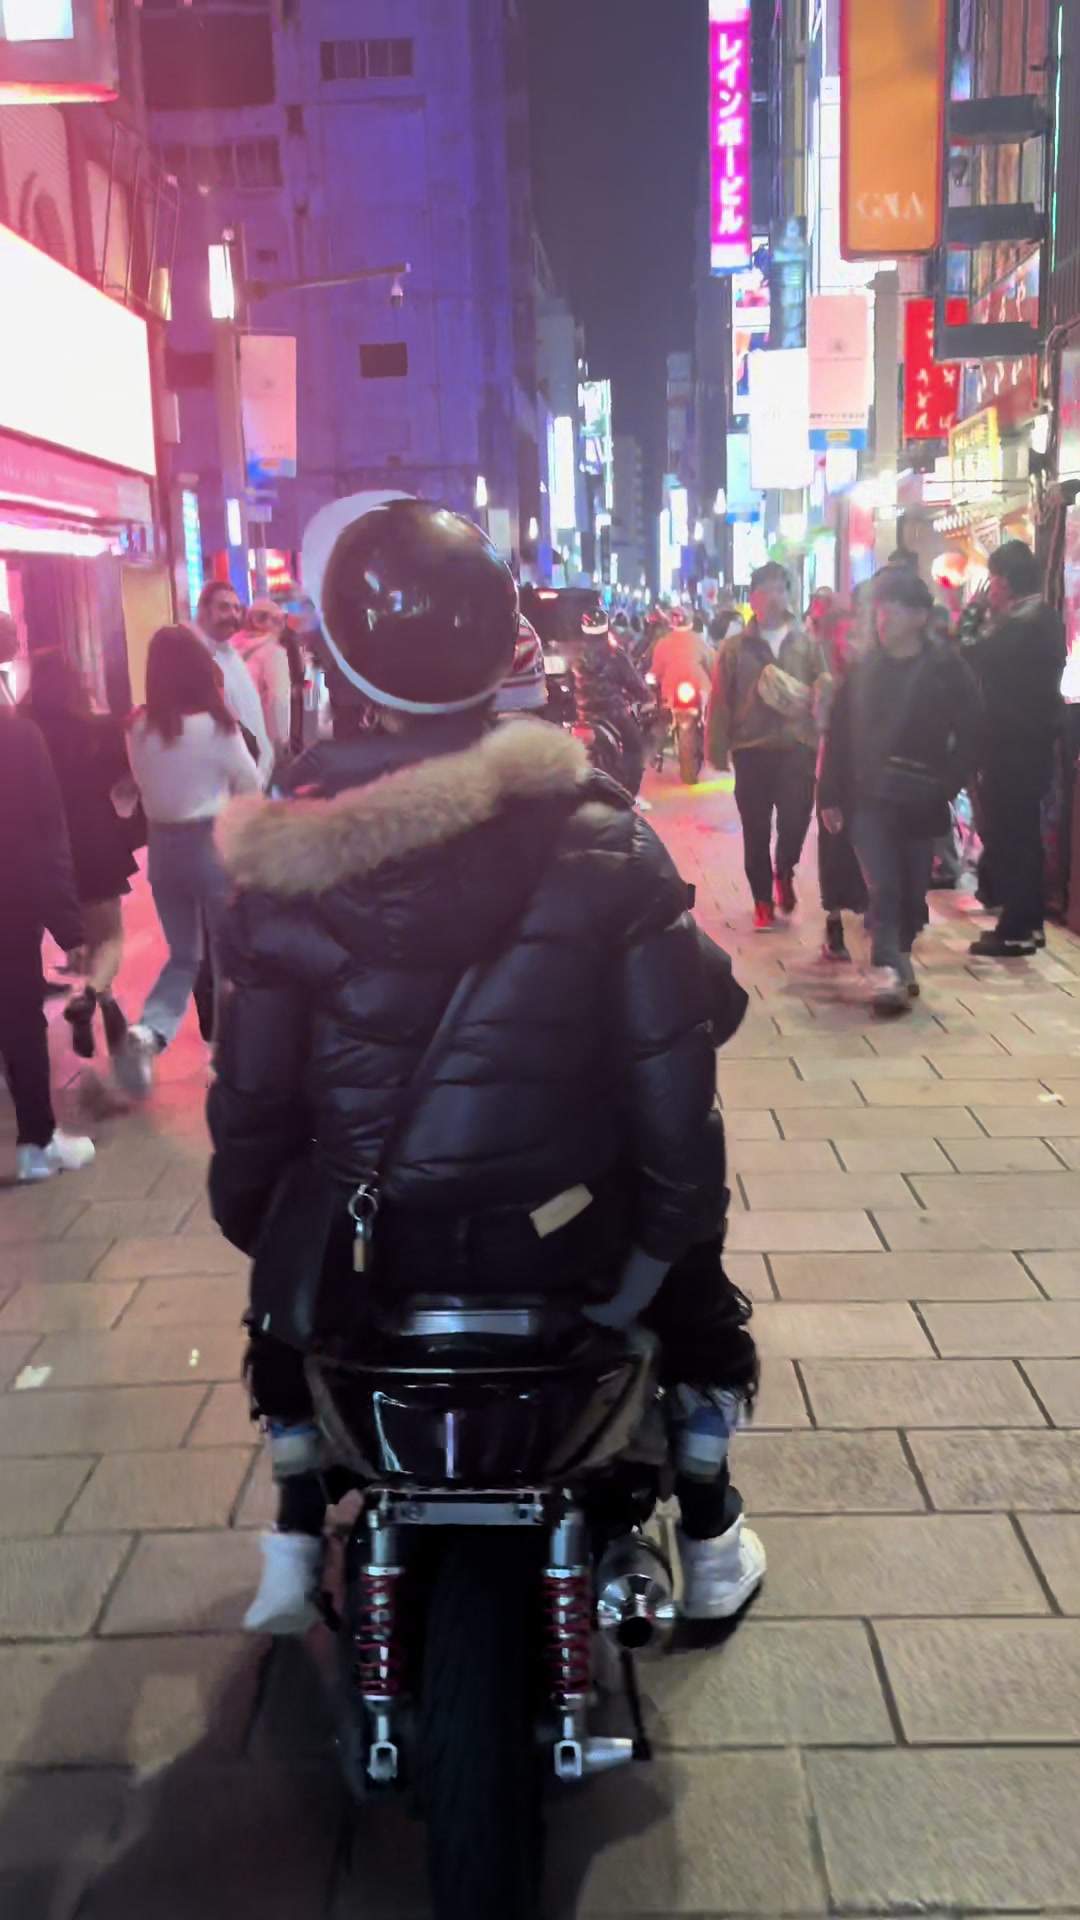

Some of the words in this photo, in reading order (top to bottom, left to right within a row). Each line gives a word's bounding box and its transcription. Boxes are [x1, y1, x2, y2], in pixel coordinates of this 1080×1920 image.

[718, 33, 744, 235] レインボービル
